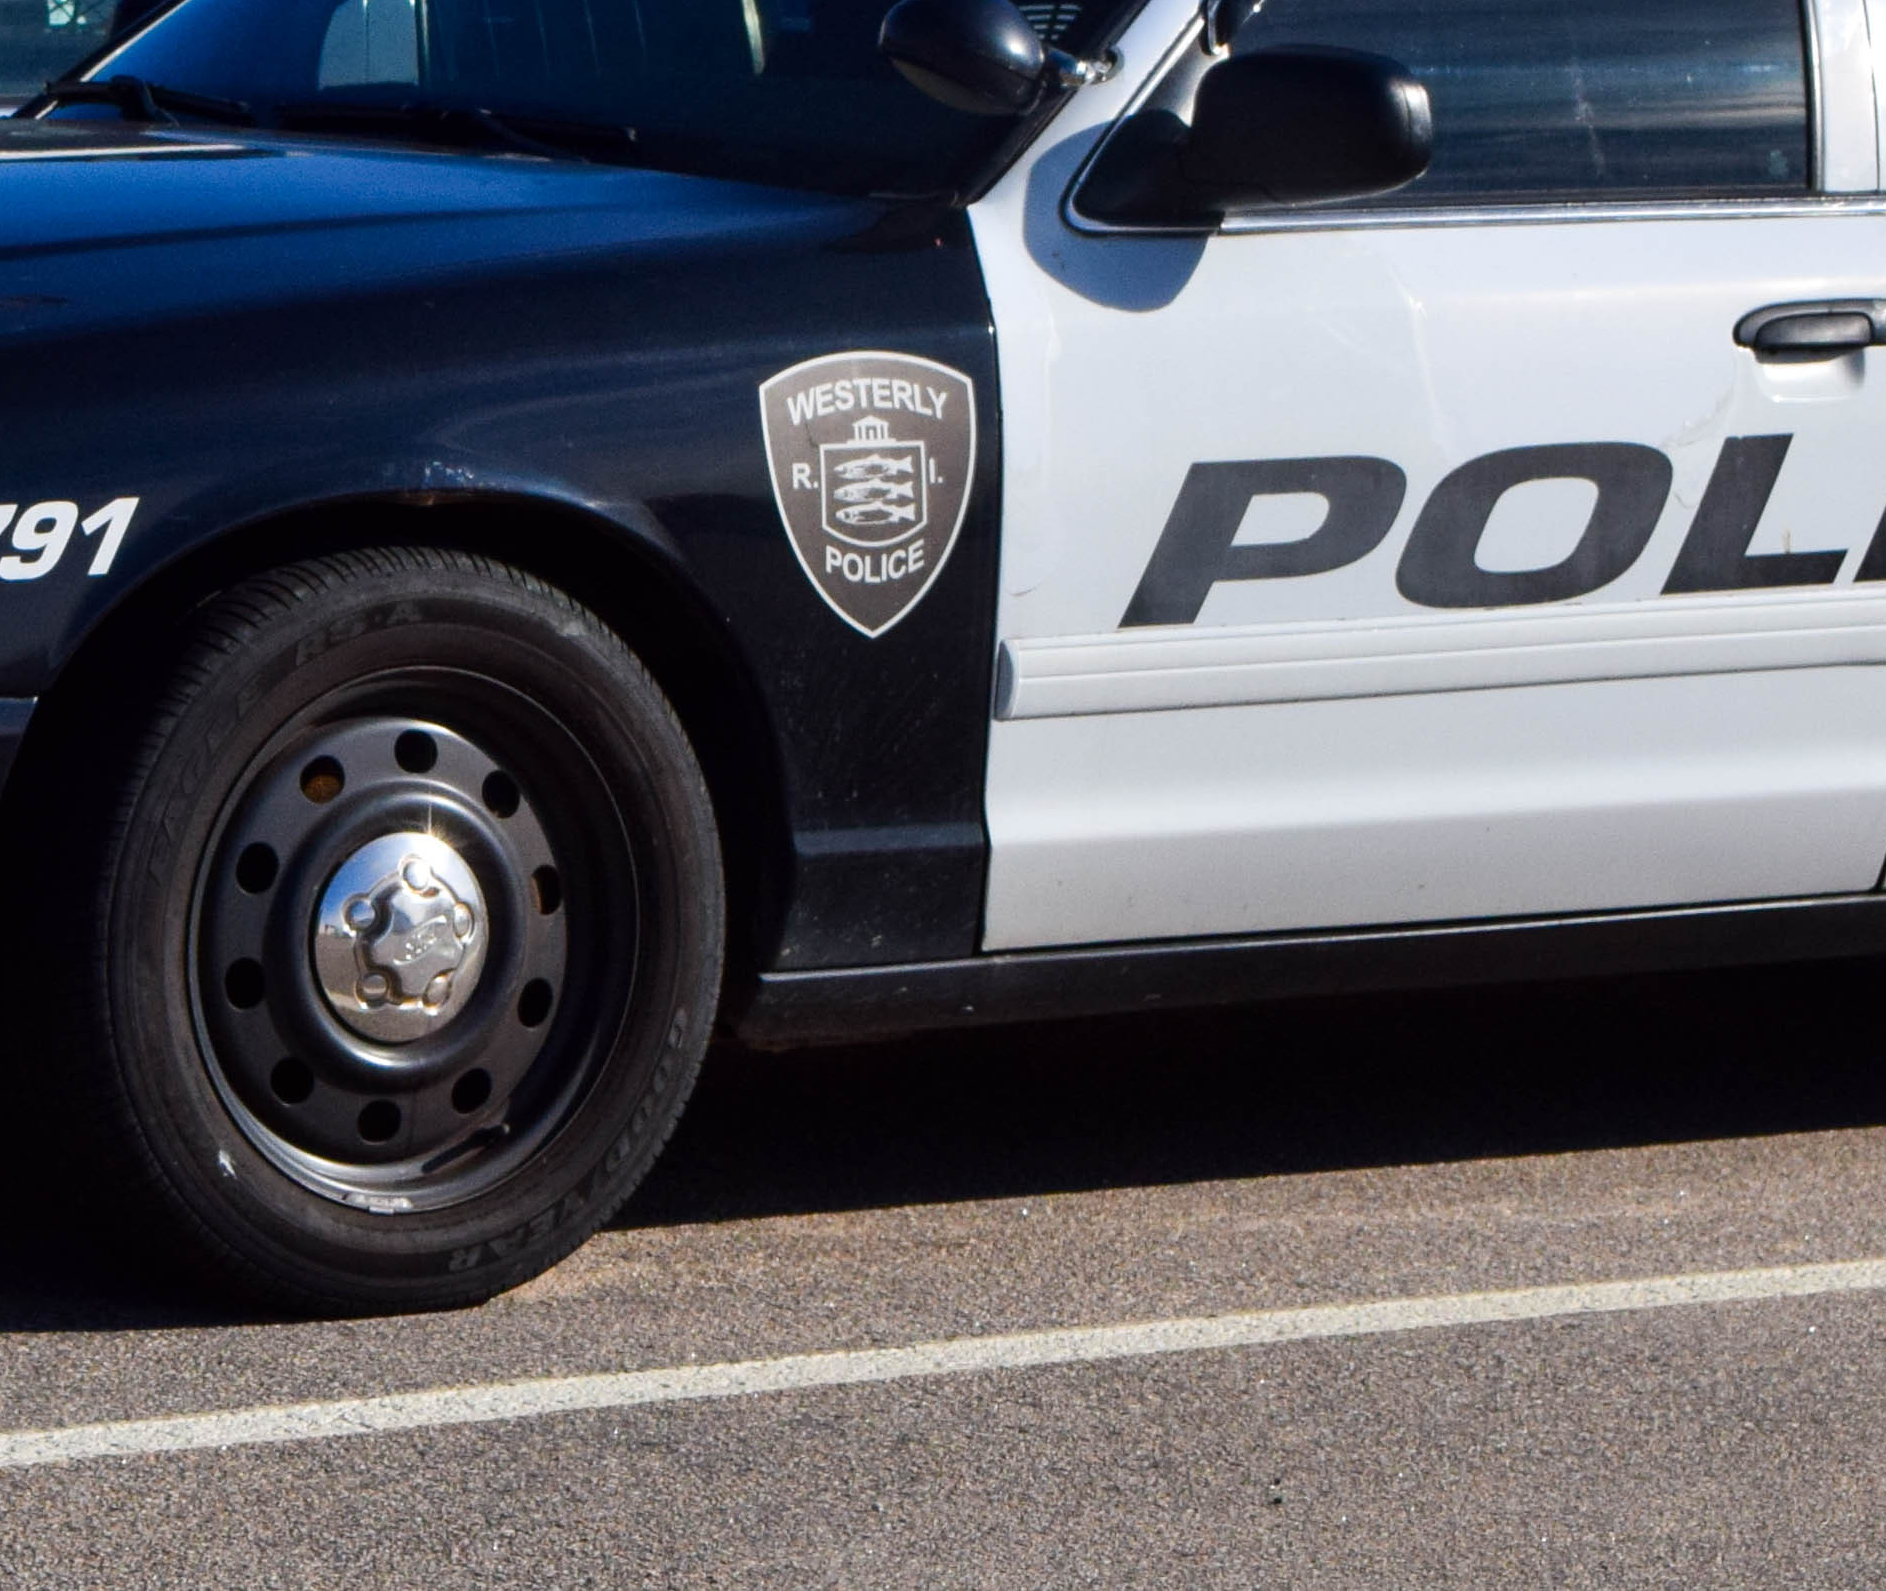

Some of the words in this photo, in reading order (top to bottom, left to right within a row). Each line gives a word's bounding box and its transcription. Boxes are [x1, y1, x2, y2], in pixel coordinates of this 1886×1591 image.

[786, 377, 947, 426] WESTERLY
[791, 462, 819, 490] R.
[825, 539, 925, 583] POLICE
